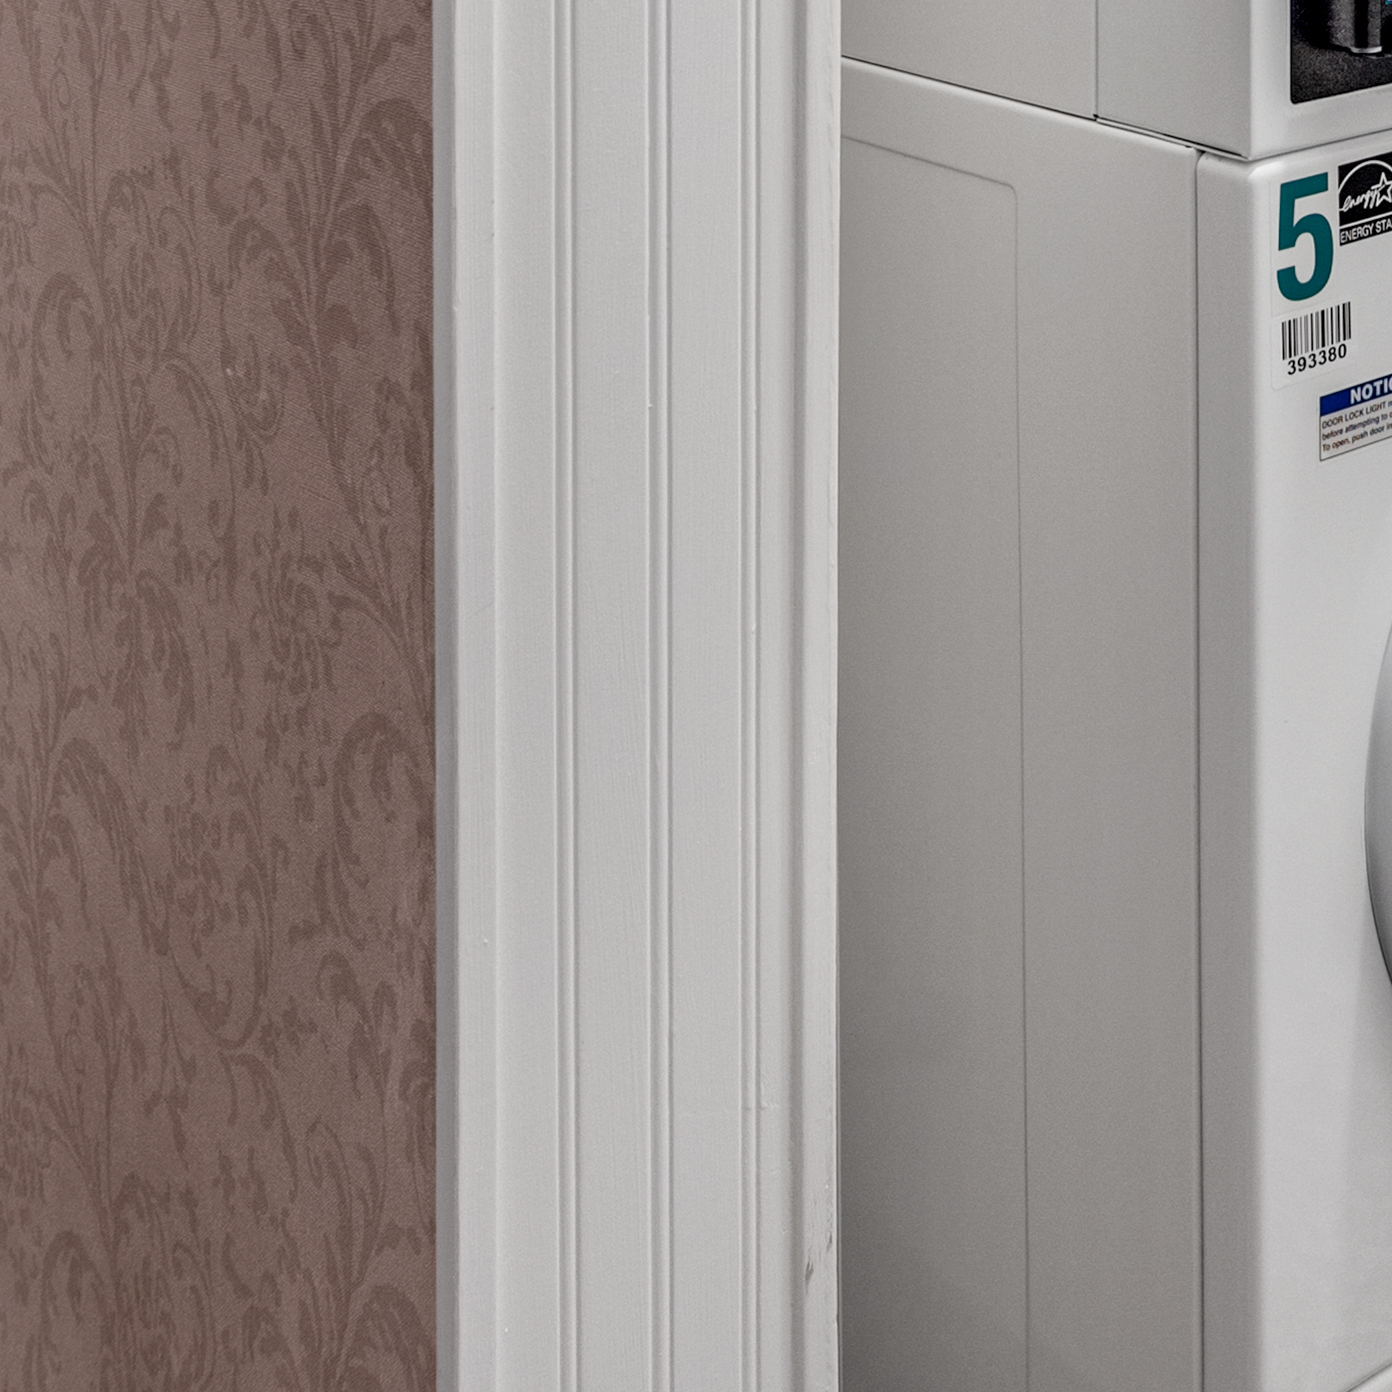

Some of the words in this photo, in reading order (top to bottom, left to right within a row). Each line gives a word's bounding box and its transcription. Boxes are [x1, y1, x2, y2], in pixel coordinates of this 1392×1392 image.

[1276, 171, 1334, 302] 5
[1340, 222, 1374, 243] ENERGY
[1287, 343, 1348, 376] 393380
[1322, 415, 1343, 429] DOOR
[1345, 409, 1364, 423] LOCK
[1366, 401, 1386, 415] LIGHT
[1322, 428, 1343, 441] before
[1345, 415, 1380, 432] attempting
[1381, 413, 1388, 421] to
[1322, 443, 1331, 452] To
[1352, 431, 1368, 444] push
[1370, 424, 1385, 435] door
[1386, 421, 1392, 429] in
